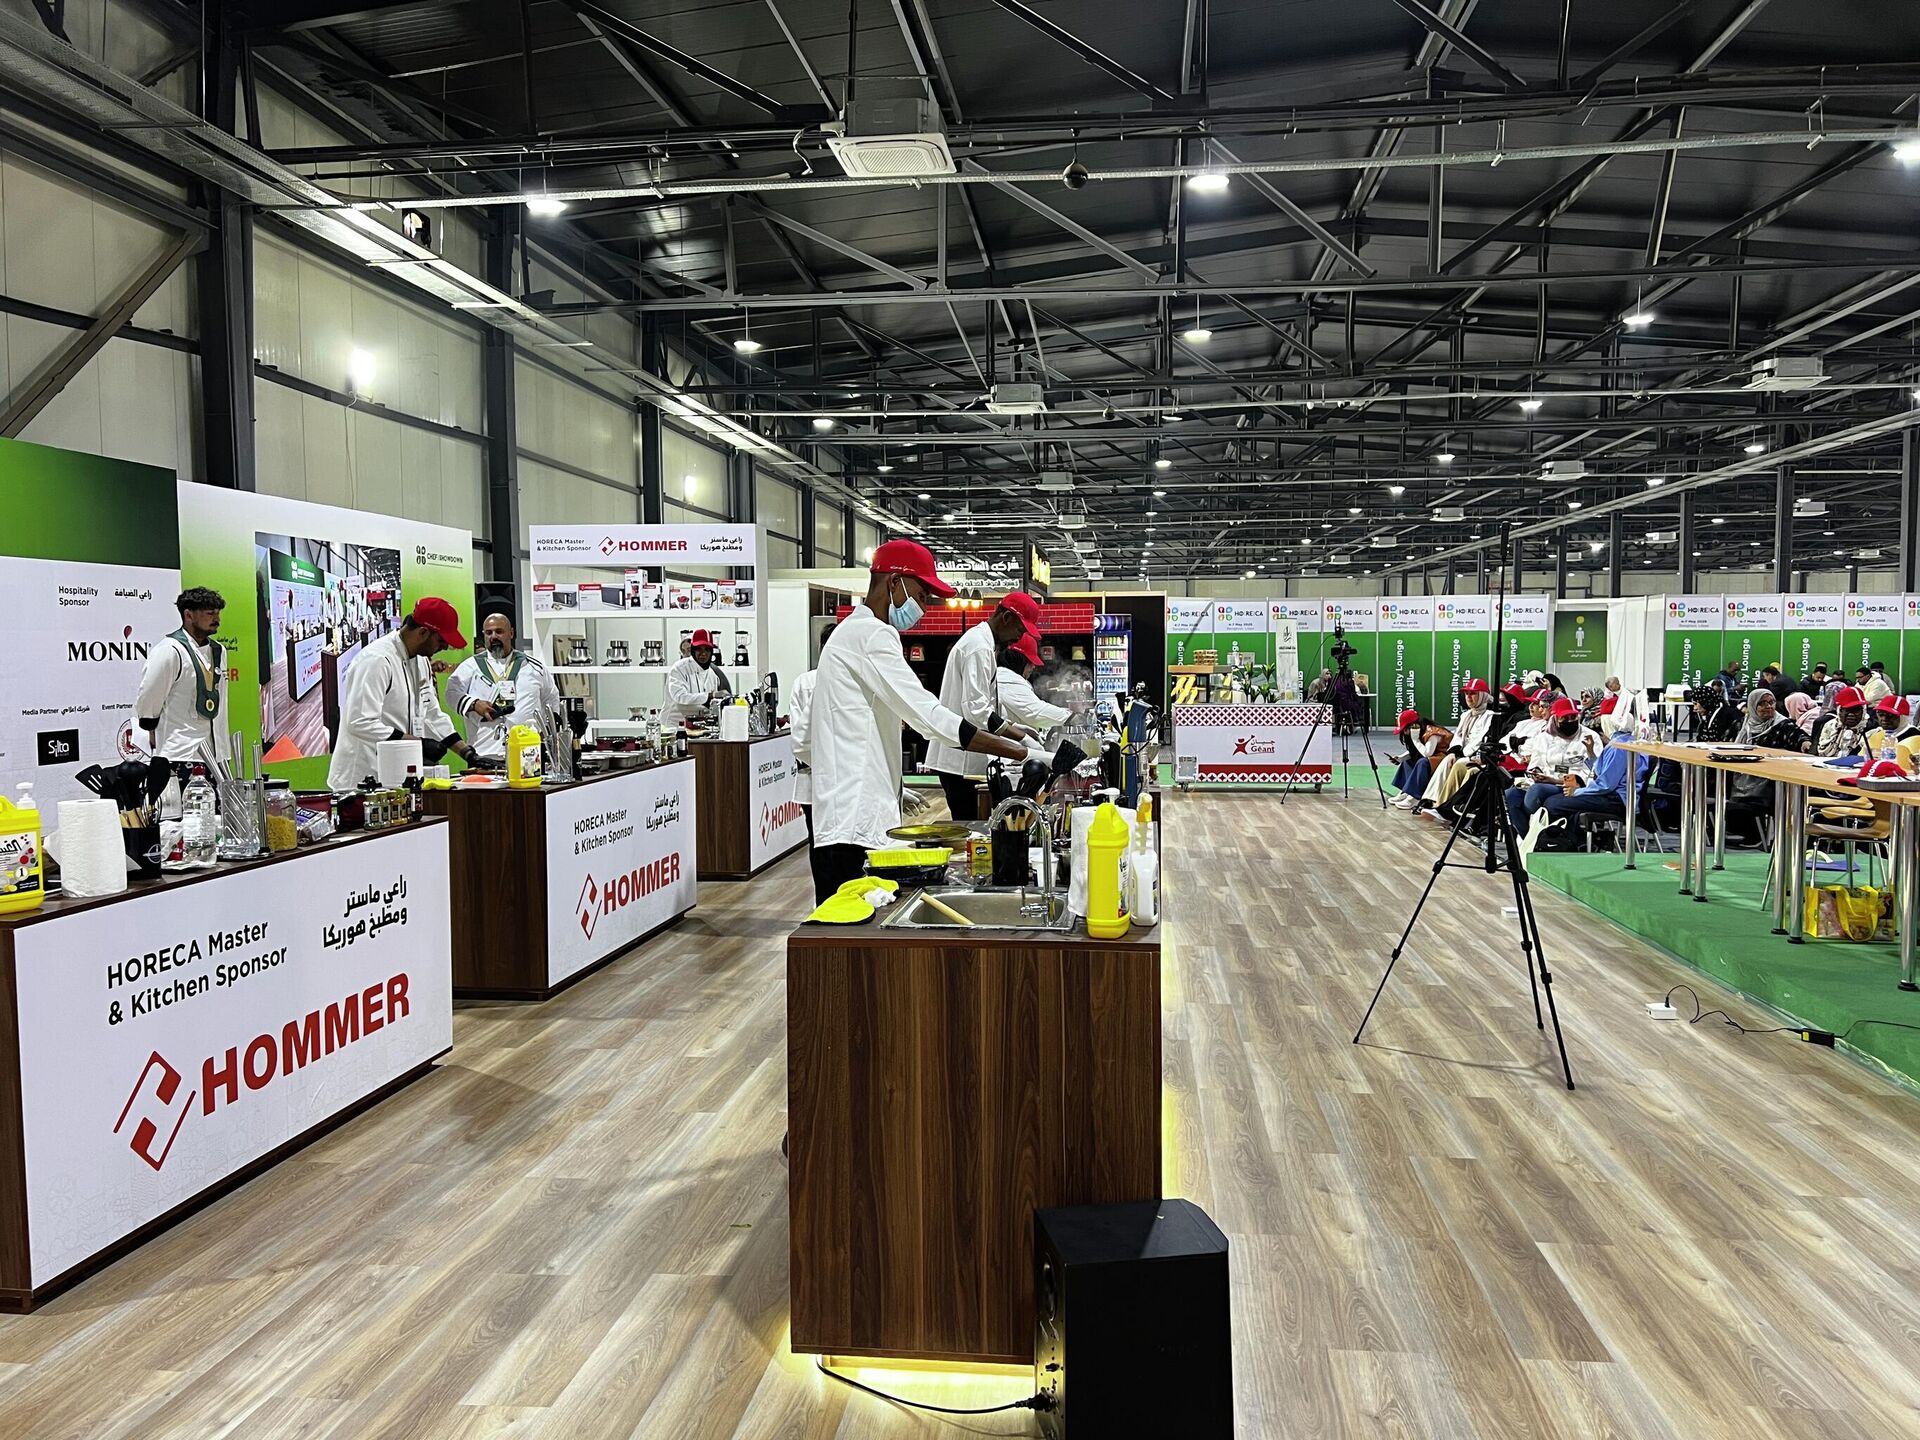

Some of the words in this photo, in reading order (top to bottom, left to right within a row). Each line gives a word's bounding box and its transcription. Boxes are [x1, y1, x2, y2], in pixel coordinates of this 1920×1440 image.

[618, 541, 688, 551] HOMMER
[58, 586, 99, 597] Hospitality
[59, 598, 90, 607] Sponsor
[114, 588, 138, 598] الضيافة
[138, 590, 152, 601] راعي
[68, 641, 148, 662] MONIN
[1396, 640, 1404, 671] Lounge
[1452, 639, 1460, 671] Lounge
[1509, 639, 1518, 670] Lounge
[1682, 638, 1691, 671] Lounge
[1741, 639, 1750, 671] Lounge
[1801, 638, 1810, 670] Lounge
[1862, 638, 1870, 666] ounge
[1451, 673, 1460, 719] Hospitality
[1250, 745, 1275, 753] Géant
[574, 814, 605, 835] HORECA
[606, 808, 627, 824] Master
[771, 800, 804, 831] HOMME
[574, 842, 580, 855] &
[581, 833, 607, 853] Kitchen
[608, 825, 634, 844] Sponsor
[383, 874, 407, 910] راعي
[604, 852, 680, 916] HOMMER
[343, 884, 380, 918] ماستر
[322, 918, 366, 950] هوريكا
[368, 904, 408, 939] ومطبخ
[107, 939, 202, 989] HORECA
[208, 922, 268, 956] Master
[108, 1000, 124, 1026] &
[131, 972, 209, 1018] Kitchen
[215, 946, 288, 986] Sponsor
[201, 972, 410, 1117] HOMMER
